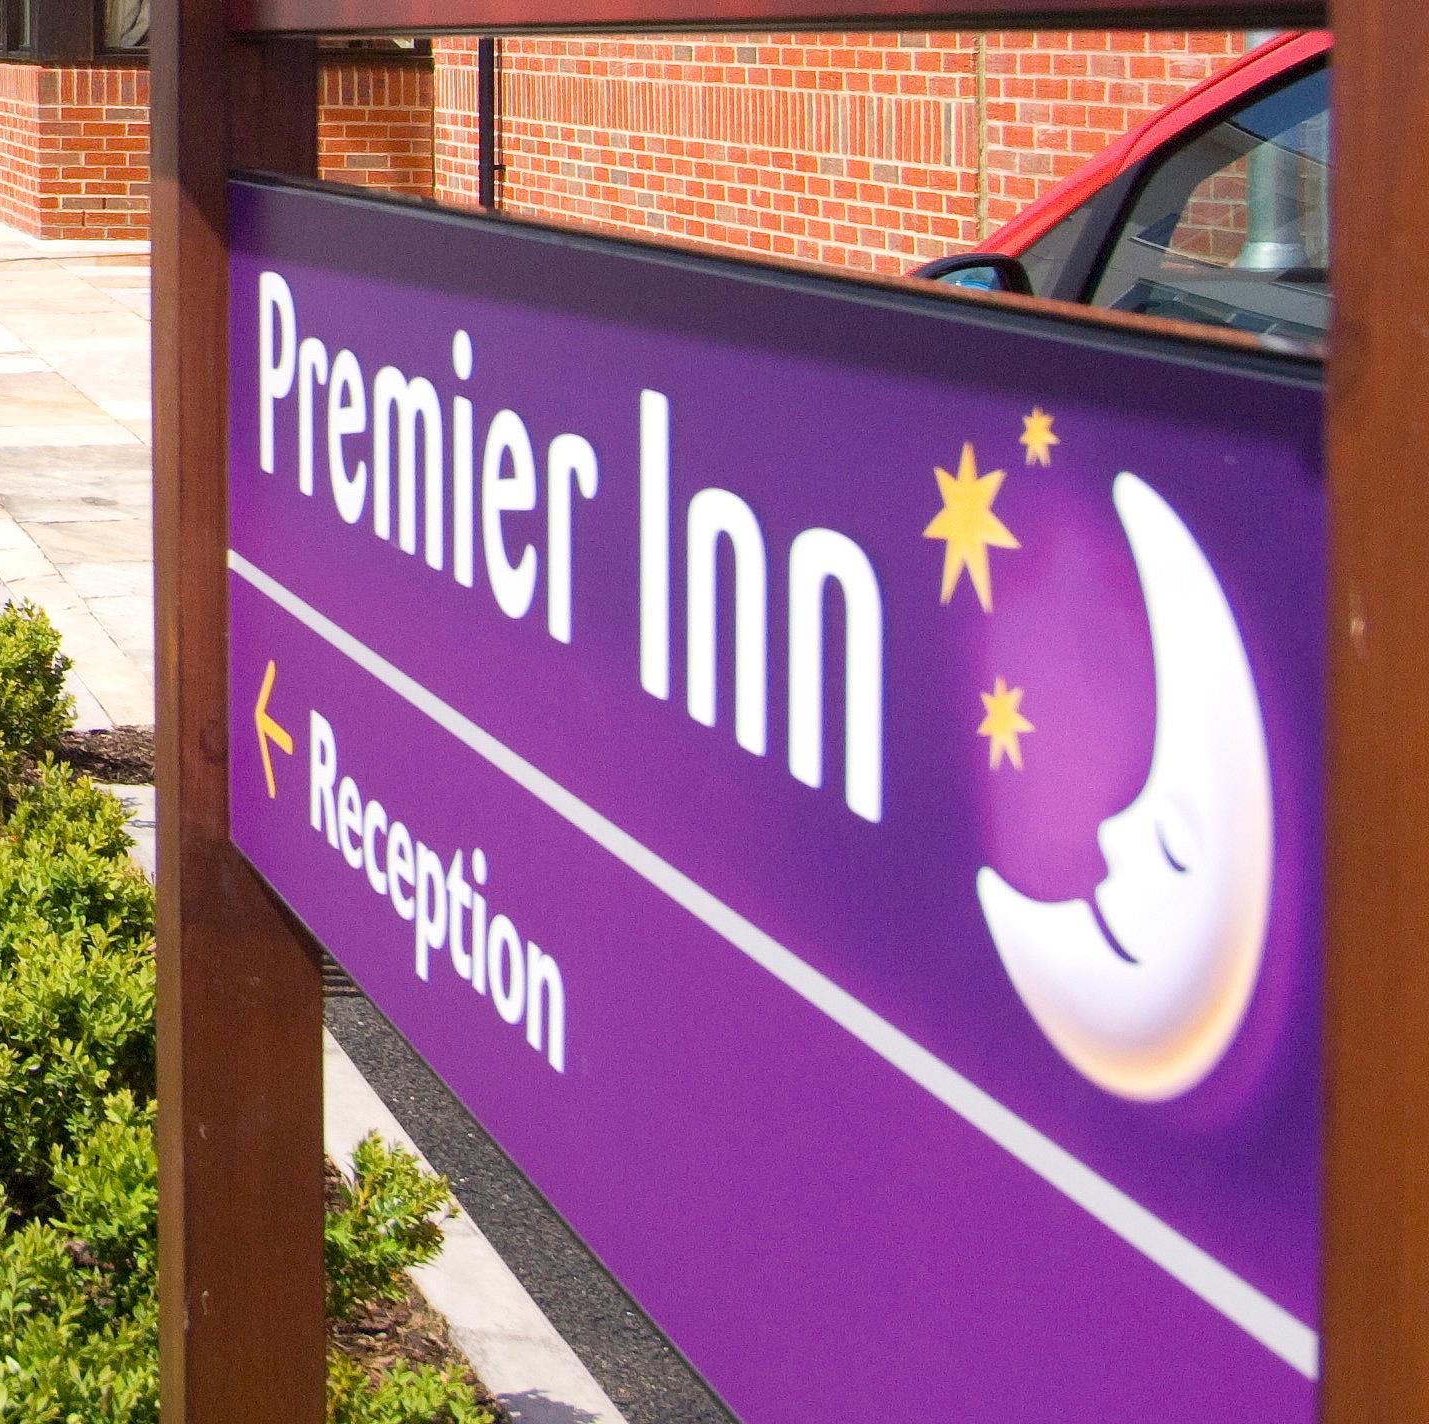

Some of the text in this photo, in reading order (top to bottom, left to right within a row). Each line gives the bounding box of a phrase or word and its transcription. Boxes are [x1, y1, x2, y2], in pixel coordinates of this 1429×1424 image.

[259, 271, 883, 824] Premier Inn
[310, 709, 566, 1073] Reception
